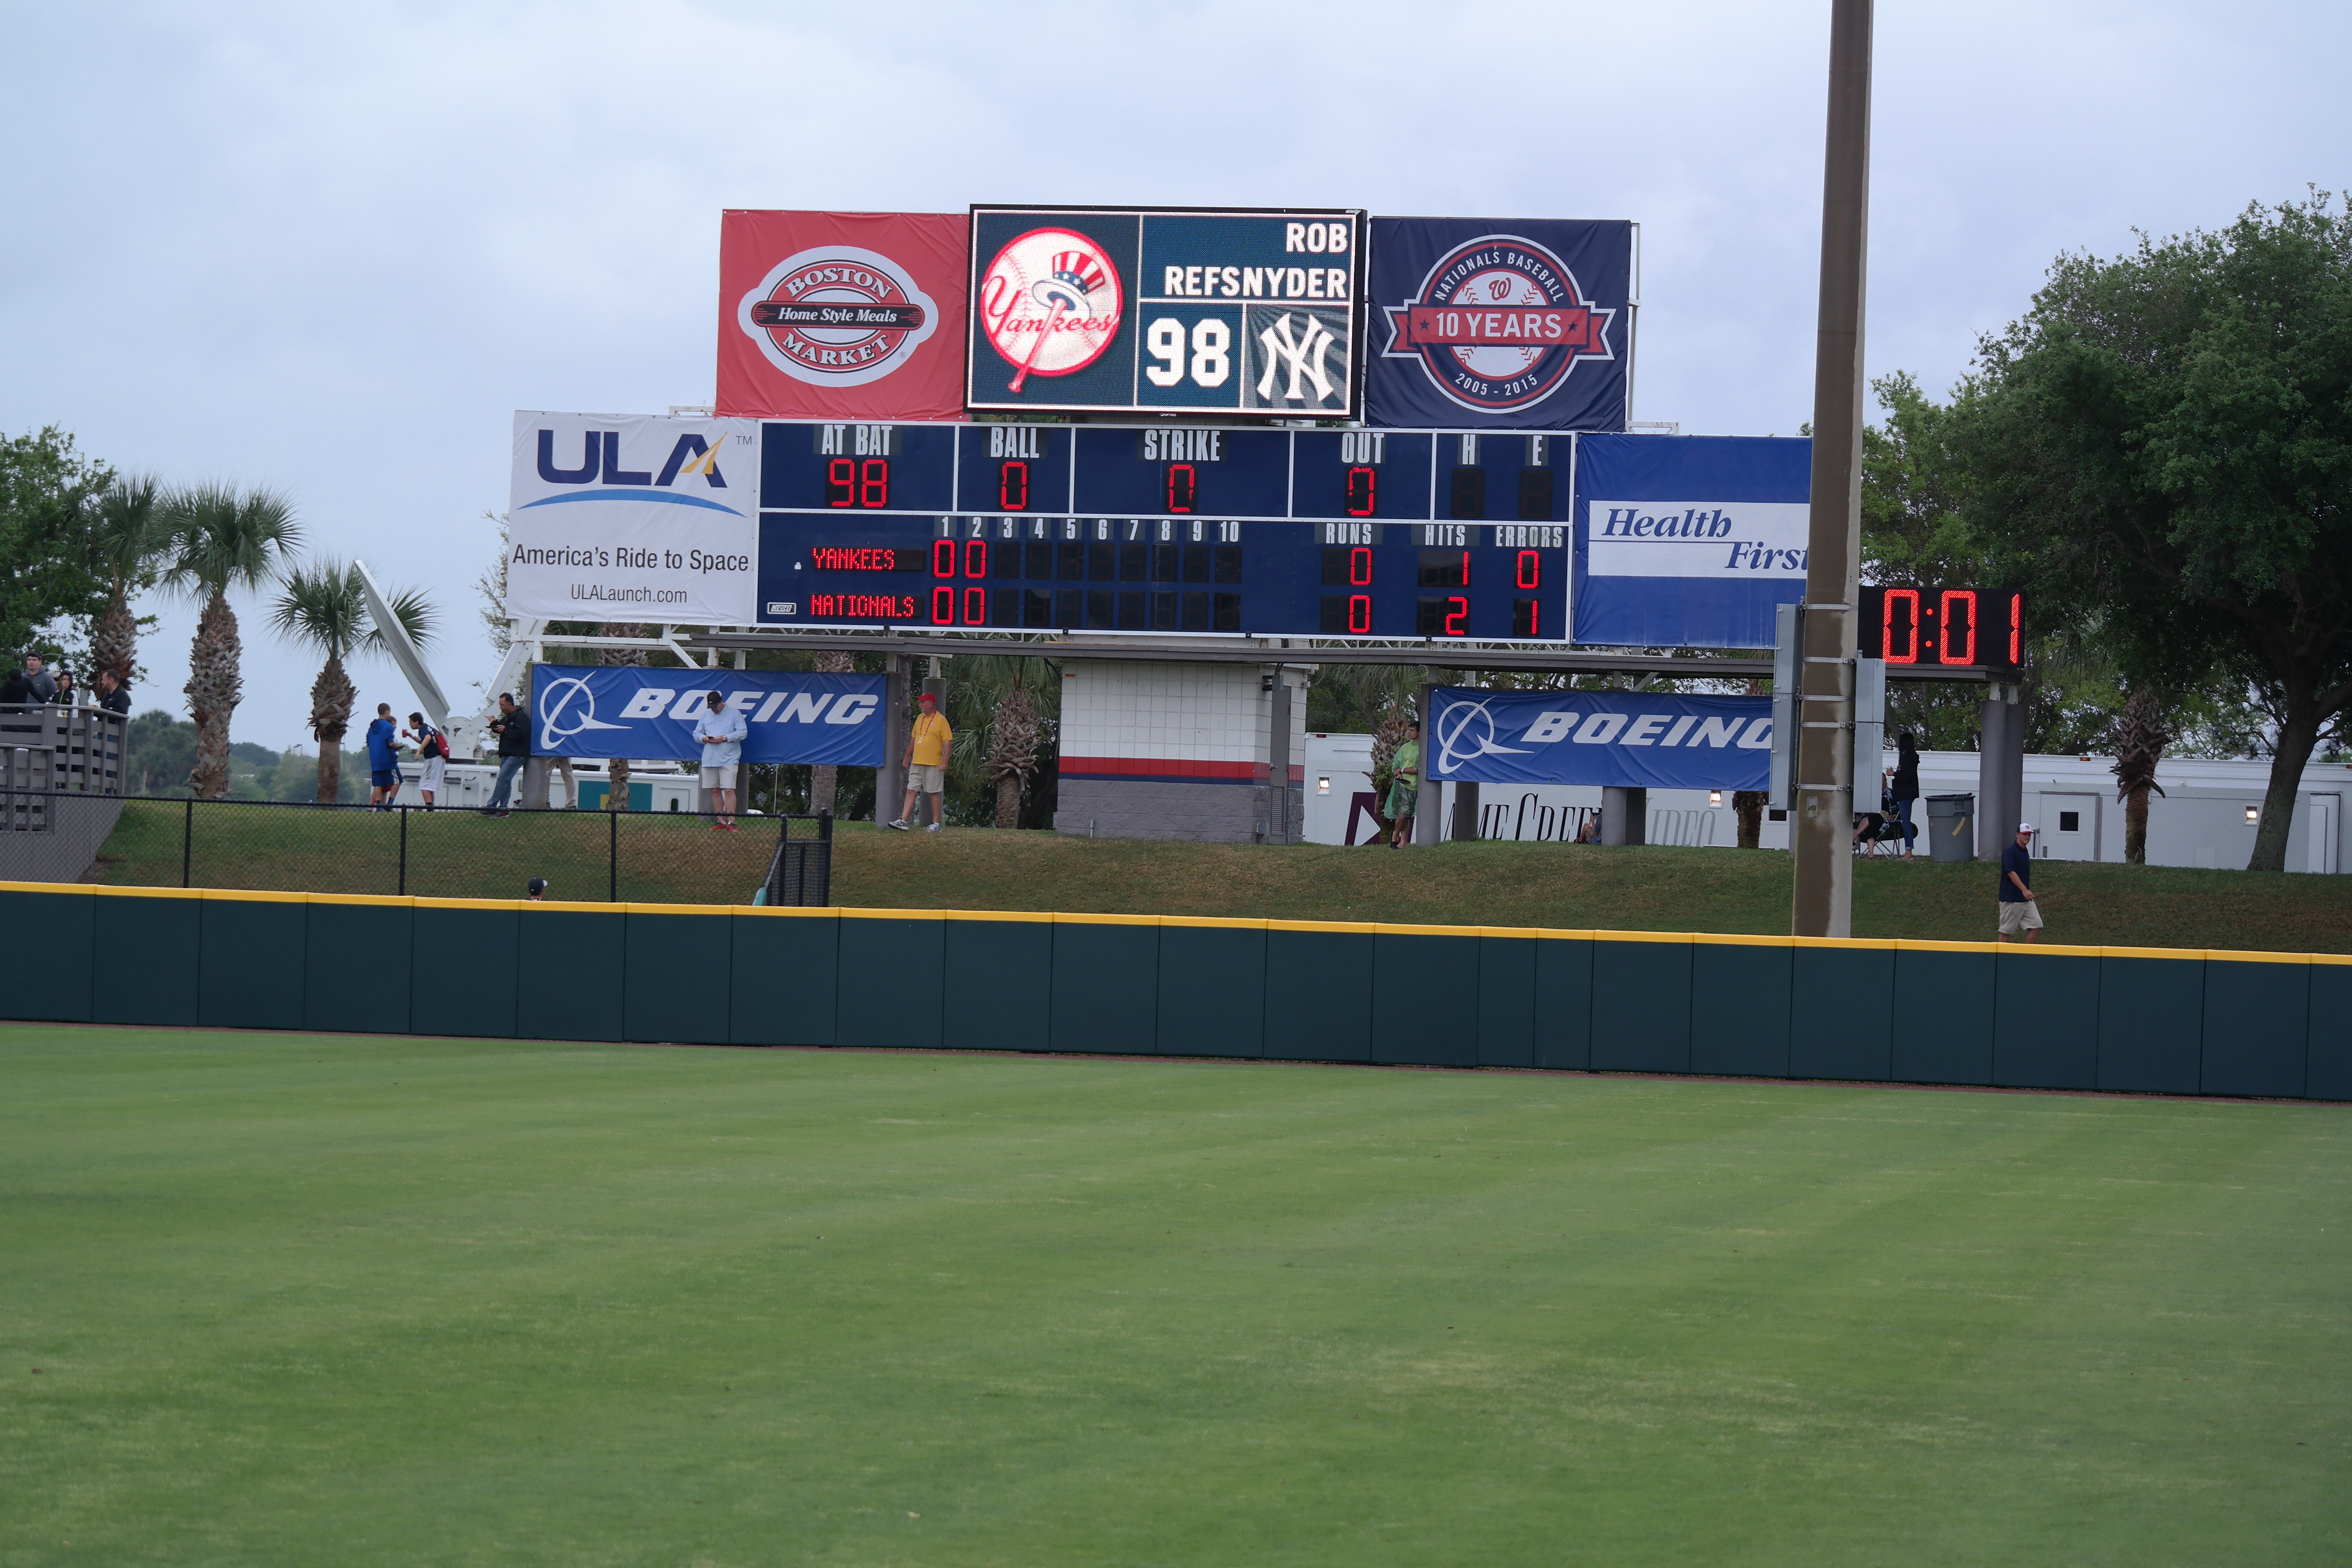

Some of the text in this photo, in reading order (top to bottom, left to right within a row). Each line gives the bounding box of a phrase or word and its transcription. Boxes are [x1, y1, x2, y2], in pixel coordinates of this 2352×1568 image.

[1286, 223, 1348, 253] ROB
[784, 266, 893, 300] BOSTON
[1165, 266, 1347, 298] REFSNYDER
[1435, 251, 1565, 302] NATIONALS BASEBALL
[1488, 277, 1512, 301] W
[778, 307, 897, 323] Home Style Meals
[981, 275, 1119, 340] Yankees
[1436, 312, 1562, 338] 10 YEARS
[781, 331, 890, 366] MARKET
[1146, 318, 1231, 387] 98
[1256, 313, 1335, 402] NY
[1455, 372, 1488, 395] 2005
[1505, 374, 1538, 396] 2015
[735, 435, 753, 445] TM
[821, 424, 893, 456] AT BAT
[990, 427, 1040, 458] BALL
[1144, 430, 1221, 461] STRIKE
[1341, 432, 1385, 464] OUT
[1462, 434, 1476, 465] H
[1532, 435, 1542, 466] E
[537, 429, 728, 488] ULA
[829, 458, 888, 508] 98
[1000, 461, 1028, 510] 0
[1168, 464, 1195, 513] 0
[1348, 467, 1375, 516] 0
[941, 517, 1240, 542] 1 2 3 4 5 6 7 8 9 10
[1326, 523, 1562, 548] RUNS HITS ERRORS
[1601, 508, 1732, 538] Health
[512, 544, 749, 574] America's Ride to Space
[812, 539, 1539, 589] YANKEES 0 0 0 1 0
[571, 584, 688, 603] ULALaunch.com
[811, 586, 1538, 635] NATIONALS 0 0 0 2 1
[1882, 588, 2021, 665] 0:01
[619, 687, 879, 726] BOEING
[1520, 711, 1773, 749] BOEING
